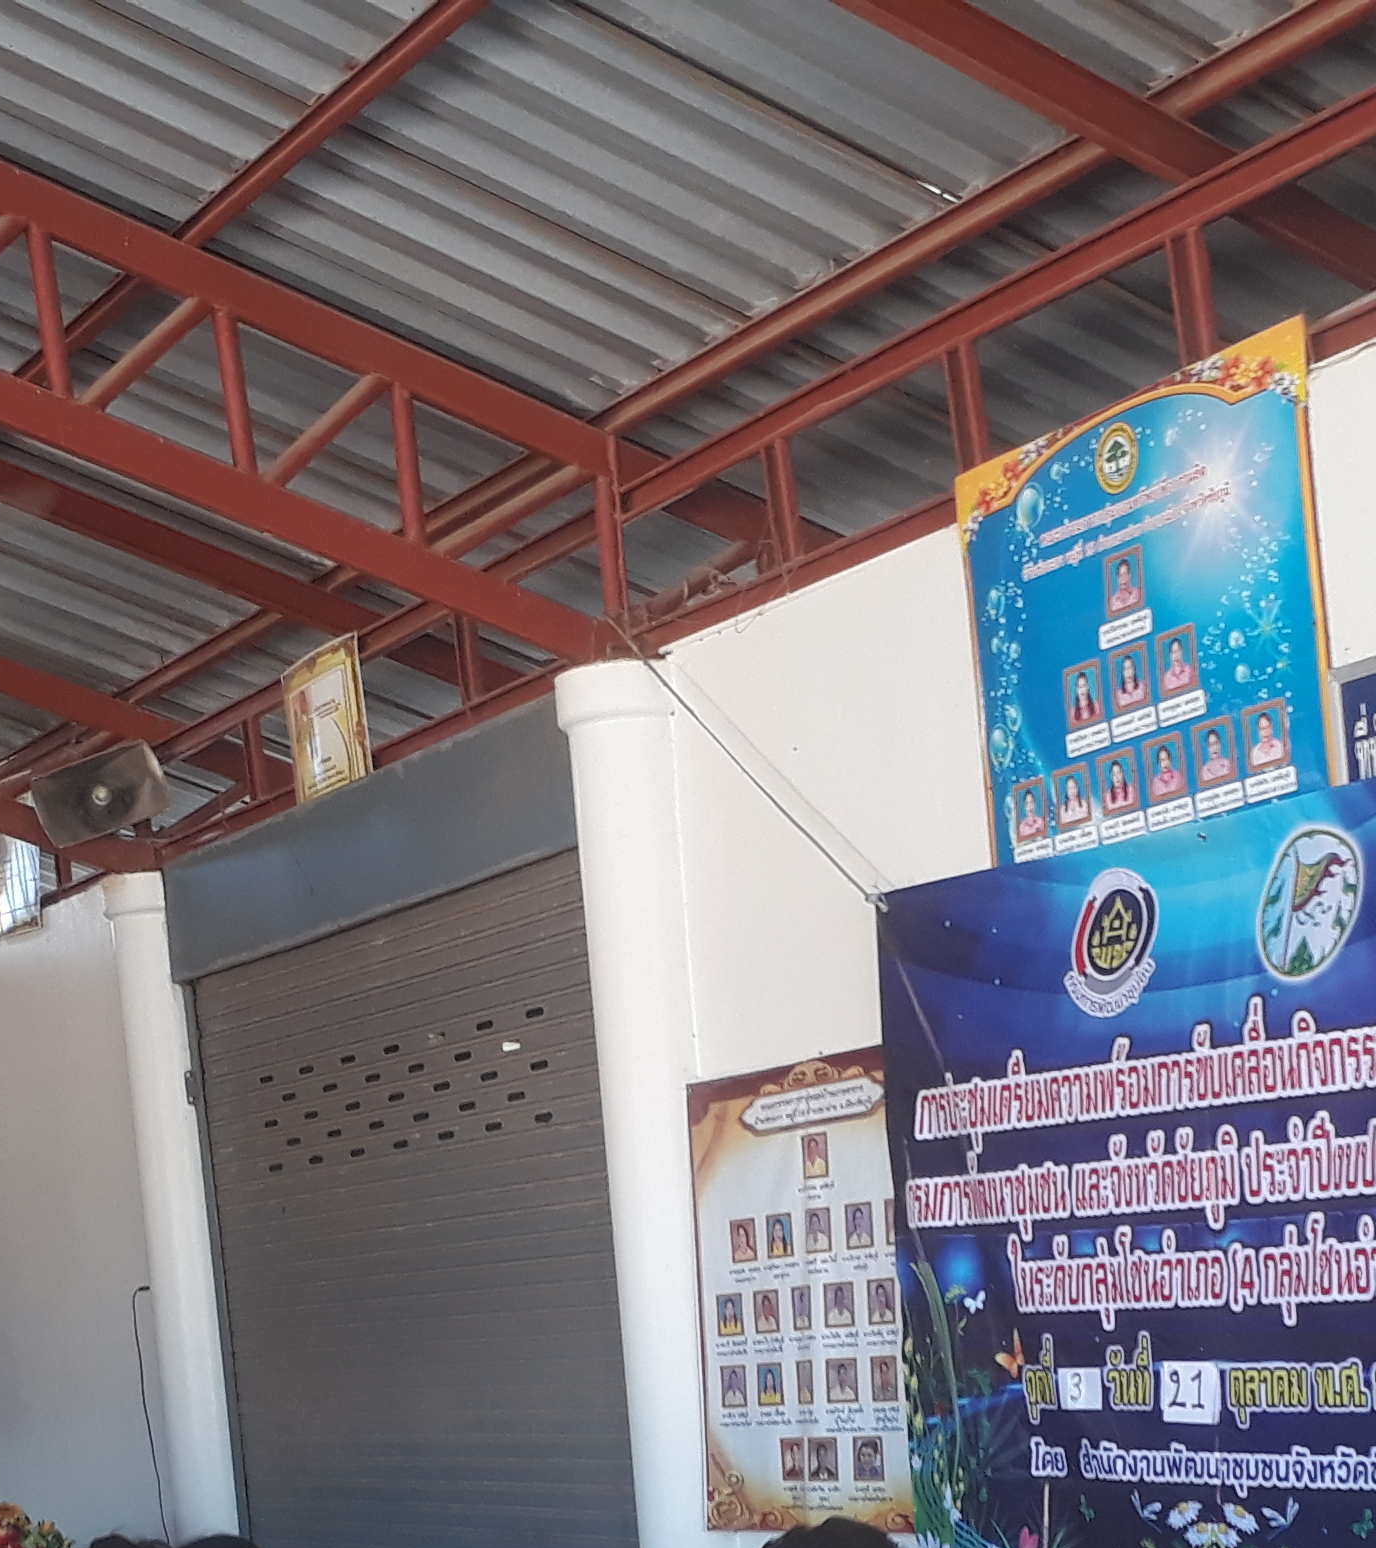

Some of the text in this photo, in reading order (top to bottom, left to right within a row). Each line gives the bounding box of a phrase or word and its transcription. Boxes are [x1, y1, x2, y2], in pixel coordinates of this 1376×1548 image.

[1073, 1124, 1239, 1230] และจังหวัดชัยภูมิ
[1023, 1332, 1059, 1426] จุดที่
[1069, 1372, 1082, 1402] 3
[1105, 1331, 1155, 1411] วันที่
[1167, 1368, 1206, 1410] 21
[1227, 1362, 1310, 1430] ตุลาคม
[1312, 1357, 1371, 1413] พ.ศ.
[1030, 1437, 1068, 1478] โดย
